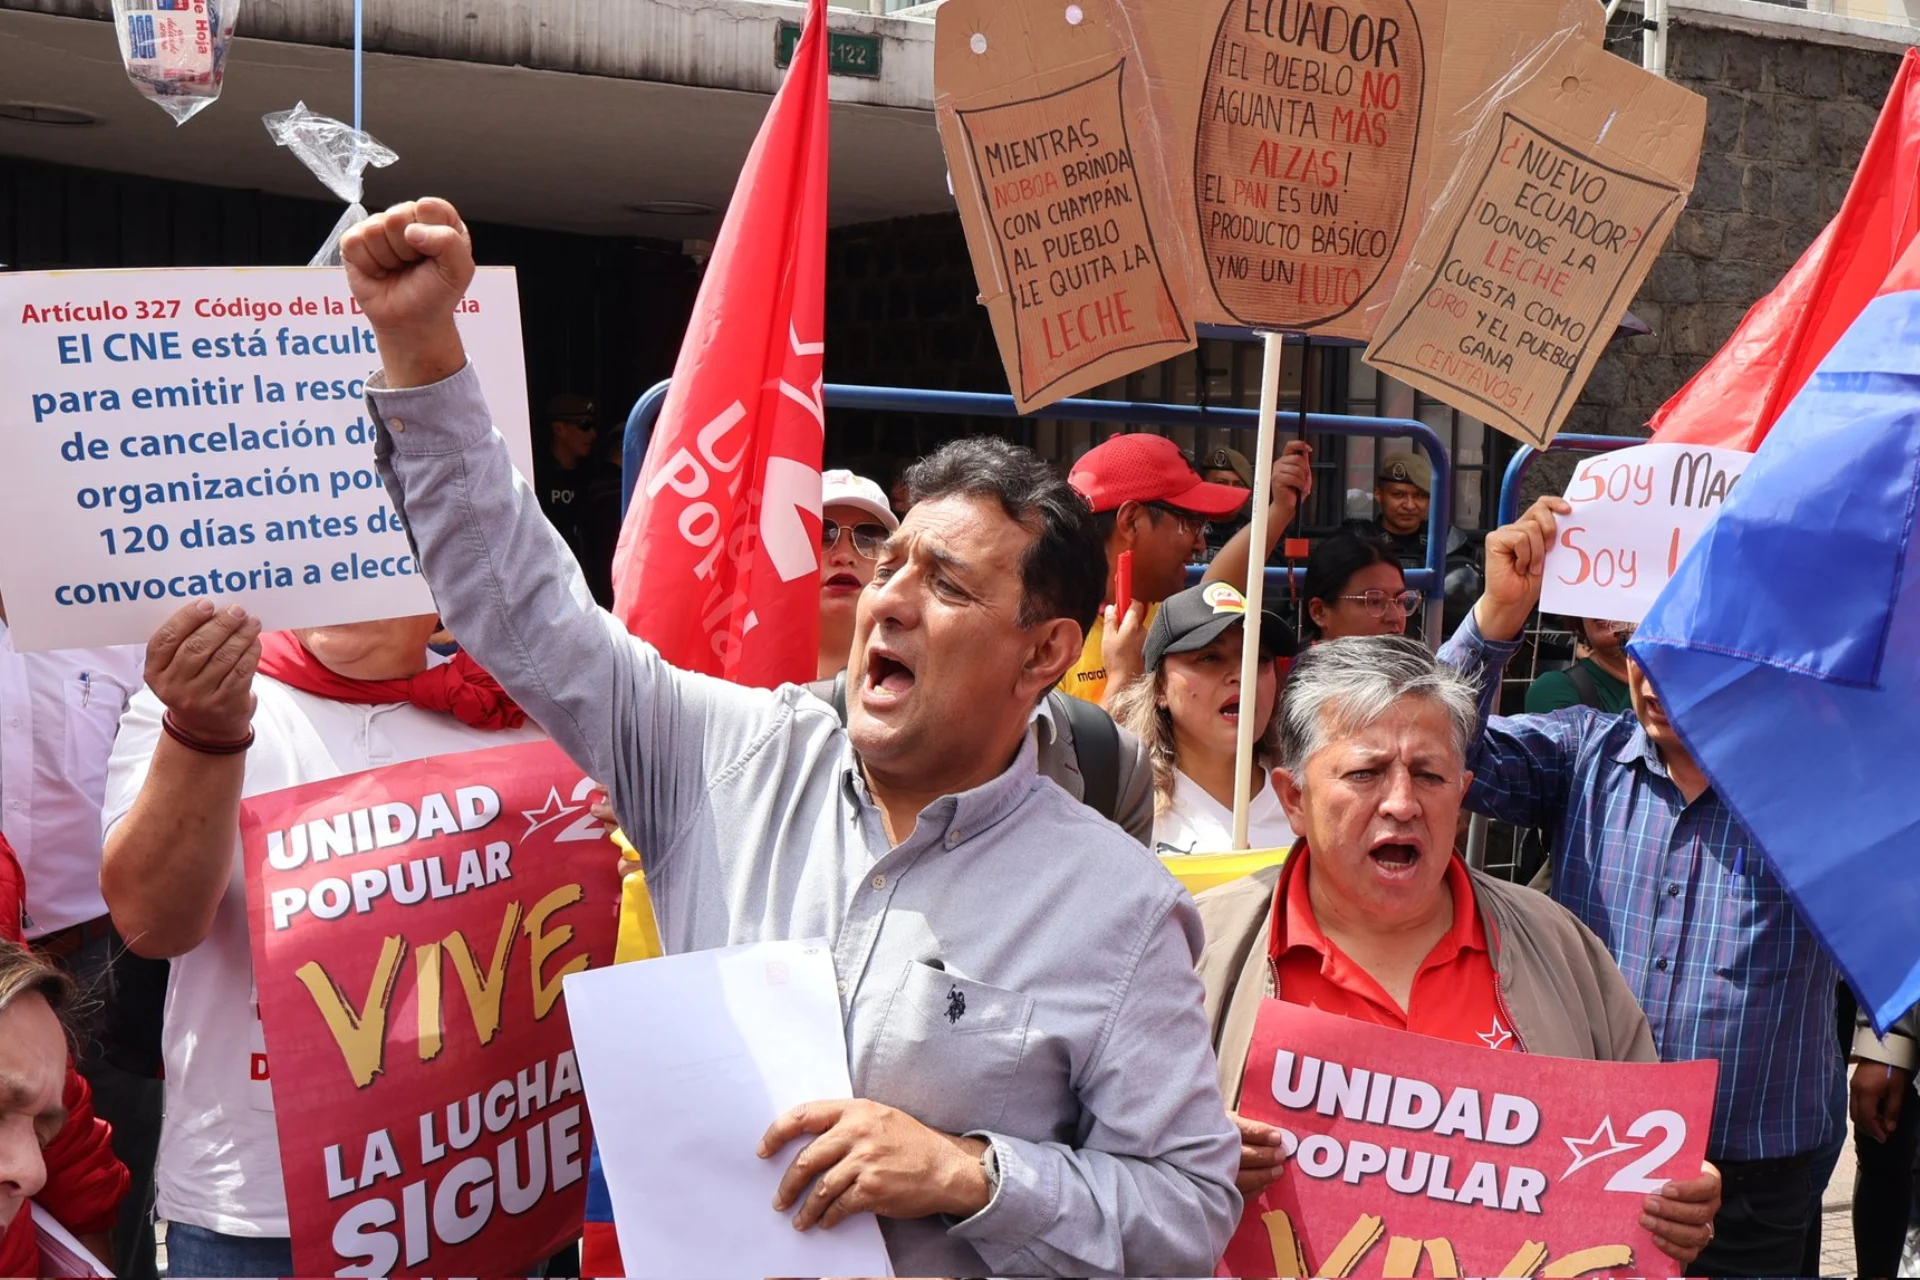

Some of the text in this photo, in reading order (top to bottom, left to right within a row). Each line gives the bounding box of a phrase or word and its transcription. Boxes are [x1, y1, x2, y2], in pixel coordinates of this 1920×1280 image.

[195, 19, 210, 54] Hoja
[1244, 0, 1400, 67] ECUADOR
[1263, 51, 1353, 97] PUEBLO
[1360, 70, 1401, 111] NO
[1213, 86, 1388, 148] AGUANTA MÁS
[984, 118, 1099, 178] MIENTRAS
[993, 171, 1059, 209] NOBOA
[1203, 173, 1339, 216] EL PAN ES UN
[1003, 212, 1041, 241] CON
[1013, 219, 1119, 275] AL PUEBLO
[1211, 211, 1300, 251] PRODUCTO
[1017, 244, 1151, 309] LE QUITA LA
[1261, 259, 1295, 286] UN
[1298, 263, 1361, 307] LUJO
[1483, 239, 1573, 297] LECHE
[1562, 247, 1598, 275] LA
[21, 299, 128, 325] Artículo
[134, 298, 182, 320] 327
[193, 296, 280, 323] Código
[288, 296, 318, 317] de
[323, 295, 346, 316] la
[1040, 290, 1135, 360] LECHE
[1426, 287, 1468, 319] ORO
[1515, 330, 1578, 370] PUEBLO
[1443, 258, 1587, 343] CUESTA COMO
[57, 322, 377, 365] El CNE está facult
[1458, 335, 1514, 374] GANA
[31, 371, 372, 423] para emitir la reso
[60, 432, 109, 463] de
[119, 418, 336, 458] cancelación
[76, 463, 320, 515] organización
[99, 524, 169, 556] 120
[180, 516, 255, 551] días
[265, 509, 360, 544] antes
[54, 558, 293, 607] convocatoria
[302, 559, 322, 585] a
[266, 784, 500, 870] UNIDAD
[270, 840, 512, 931] POPULAR
[295, 882, 592, 1091] VIVE
[323, 1049, 583, 1199] LA LUCHA
[1271, 1050, 1541, 1146] UNIDAD
[1604, 1108, 1688, 1195] 2
[332, 1104, 584, 1278] SIGUE
